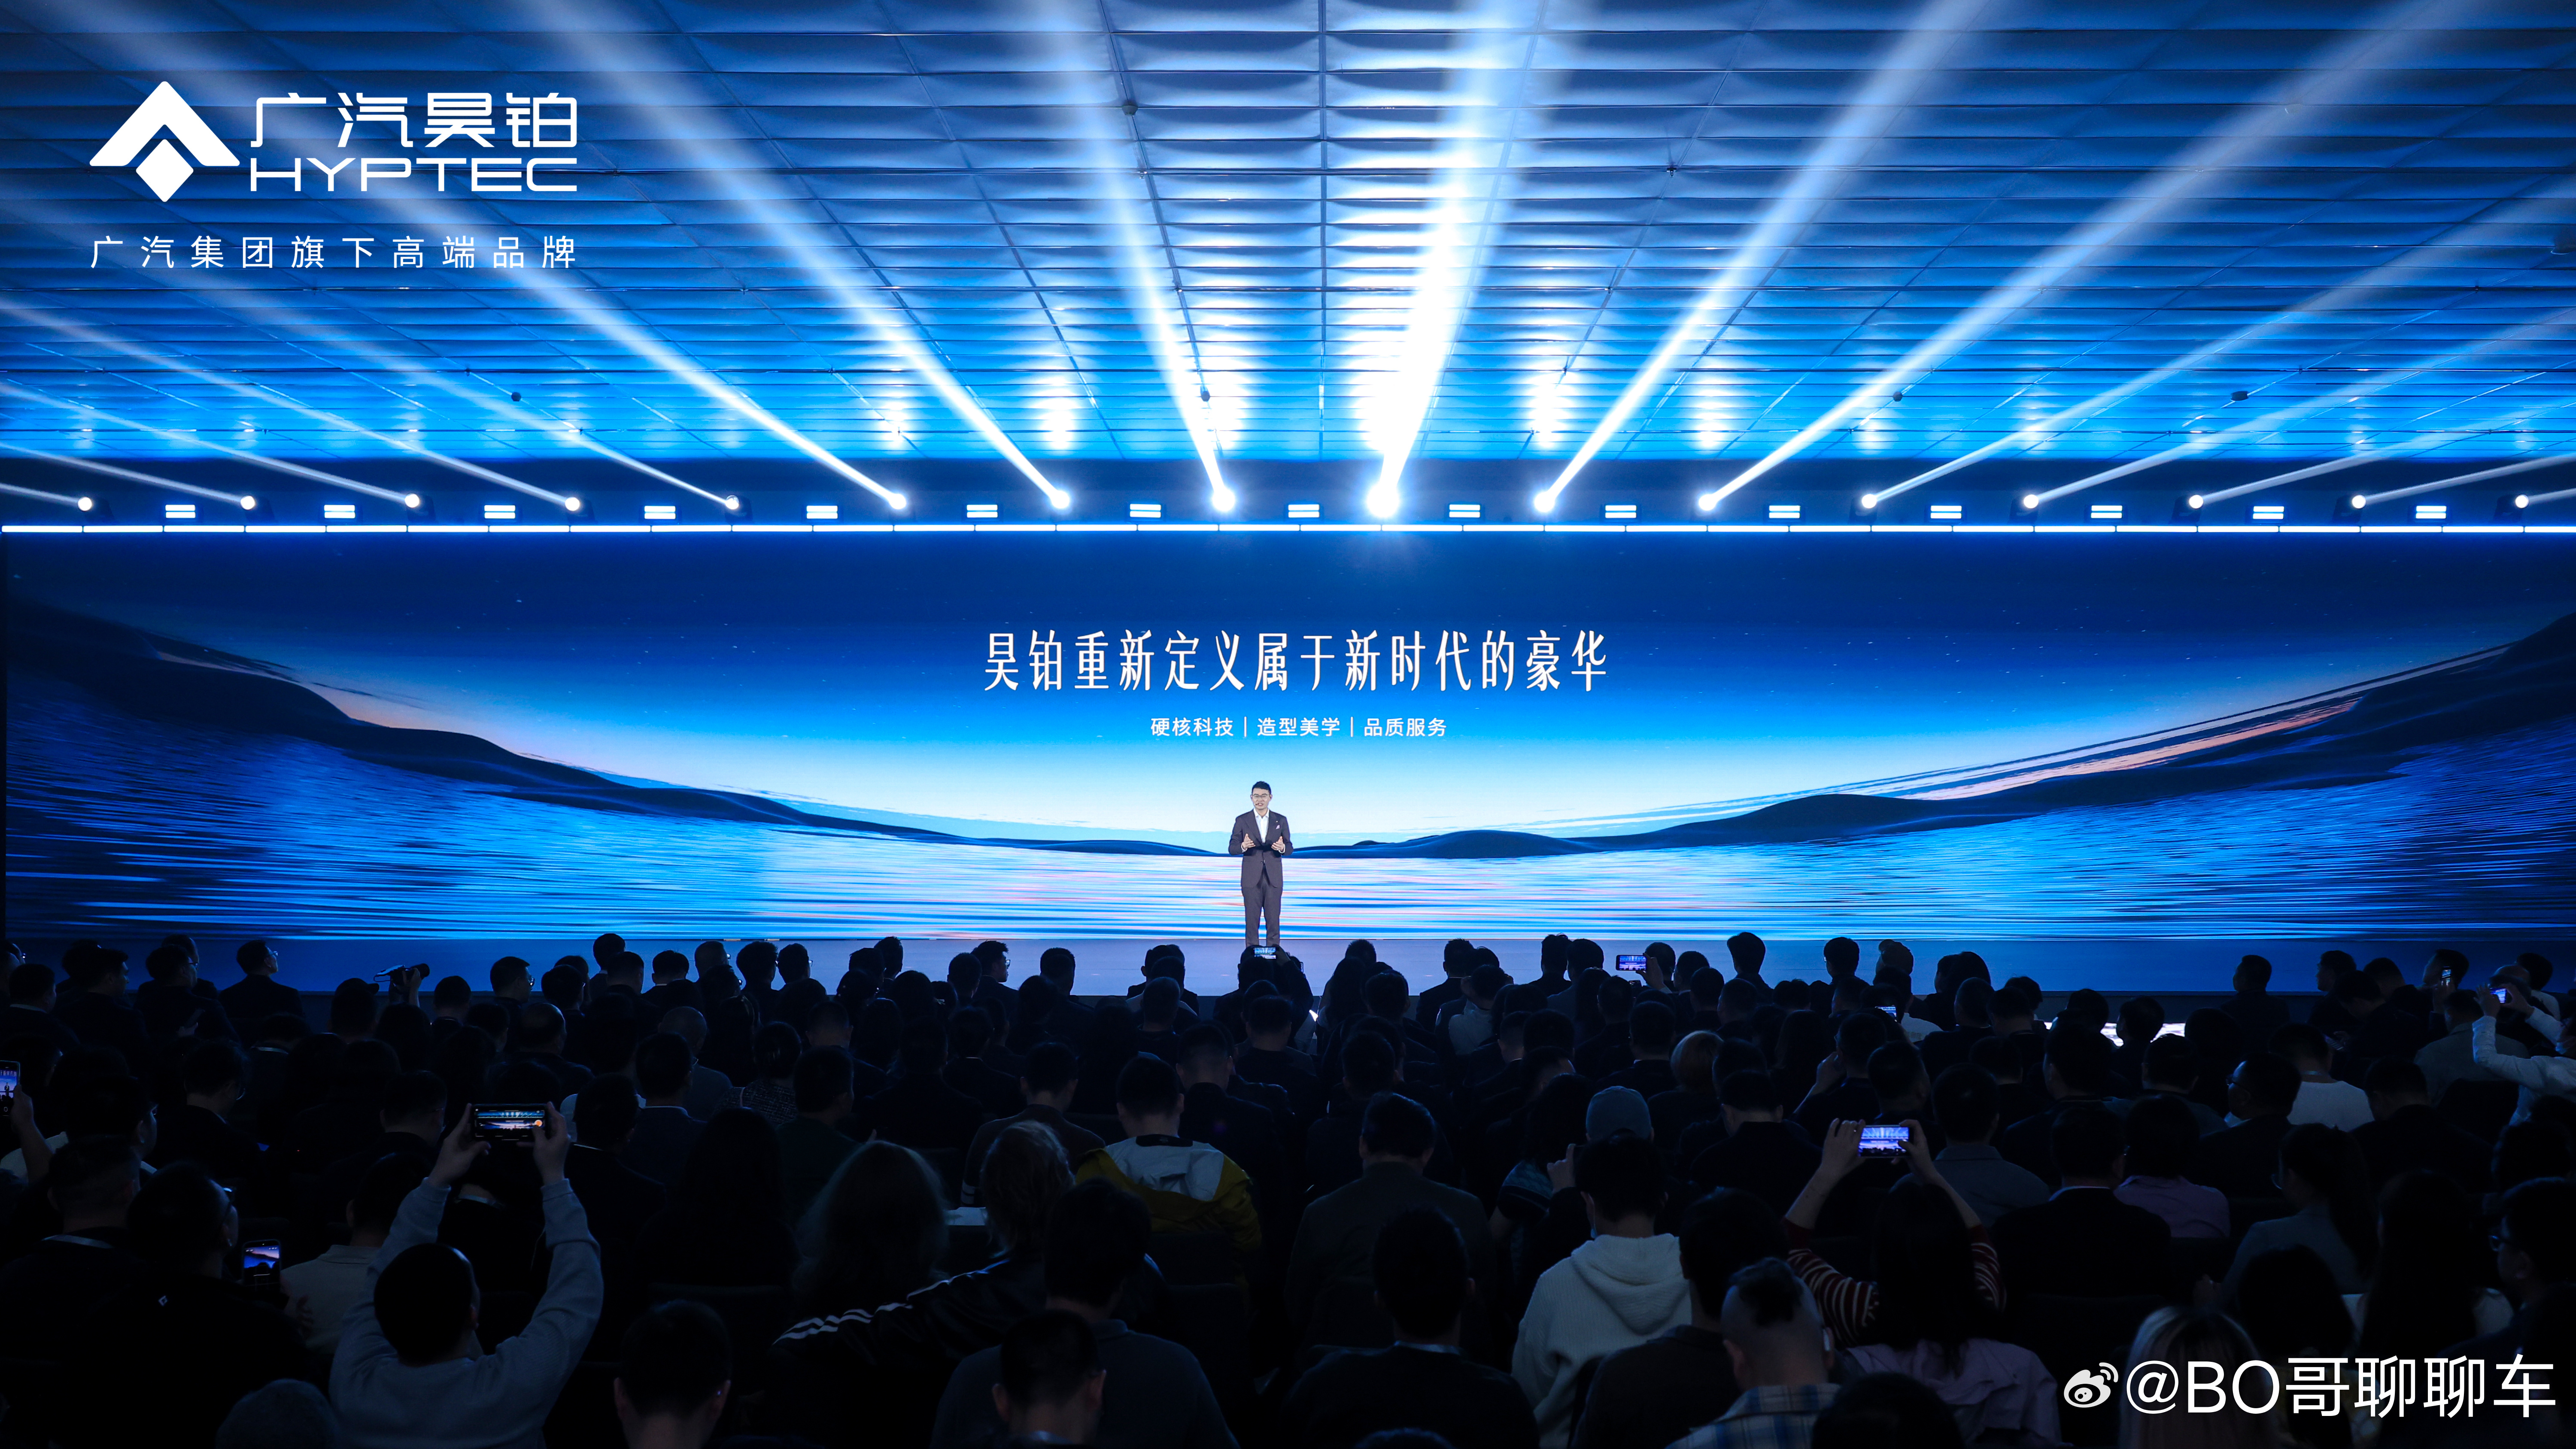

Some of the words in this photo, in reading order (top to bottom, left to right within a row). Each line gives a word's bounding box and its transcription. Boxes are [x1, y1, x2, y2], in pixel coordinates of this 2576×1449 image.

[984, 629, 1607, 692] 昊铂重新定义属于新时代的豪华
[1151, 717, 1233, 737] 硬核科技
[1257, 717, 1340, 737] 造型美学
[1364, 717, 1446, 737] 品质服务
